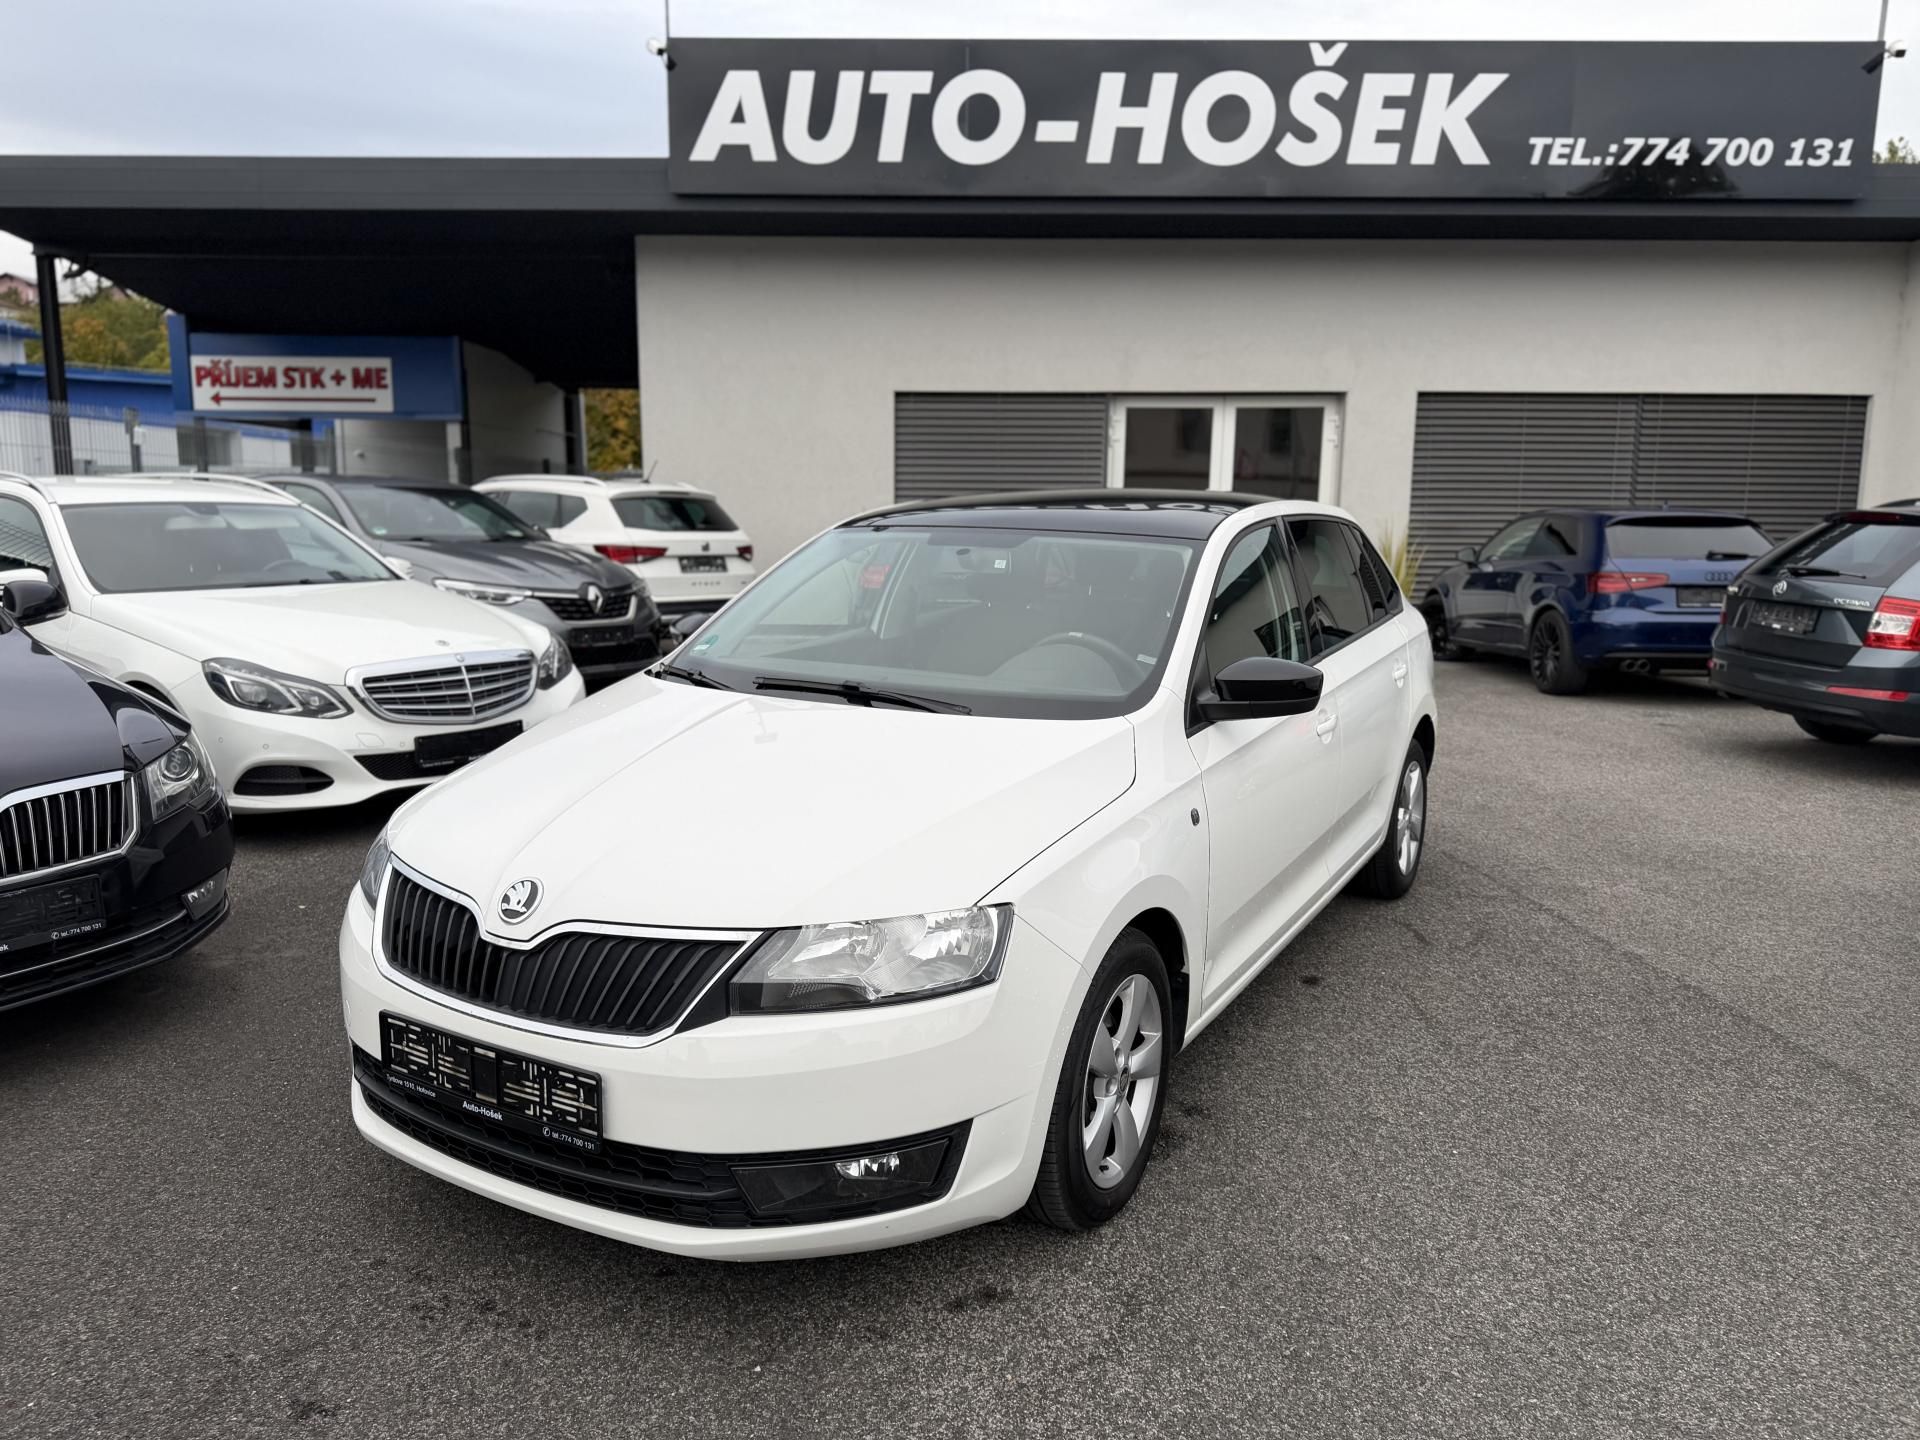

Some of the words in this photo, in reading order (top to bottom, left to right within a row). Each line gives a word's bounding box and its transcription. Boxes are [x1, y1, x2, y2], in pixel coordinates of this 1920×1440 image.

[689, 42, 1510, 166] AUTO-HOŠEK
[1528, 137, 1690, 167] TEL.:774
[1701, 137, 1775, 167] 700
[1783, 137, 1855, 168] 131
[194, 359, 277, 388] PŘÍJEM
[283, 367, 326, 389] STK
[330, 370, 346, 386] +
[352, 367, 389, 390] ME
[572, 1137, 584, 1148] 700
[585, 1141, 595, 1150] 131
